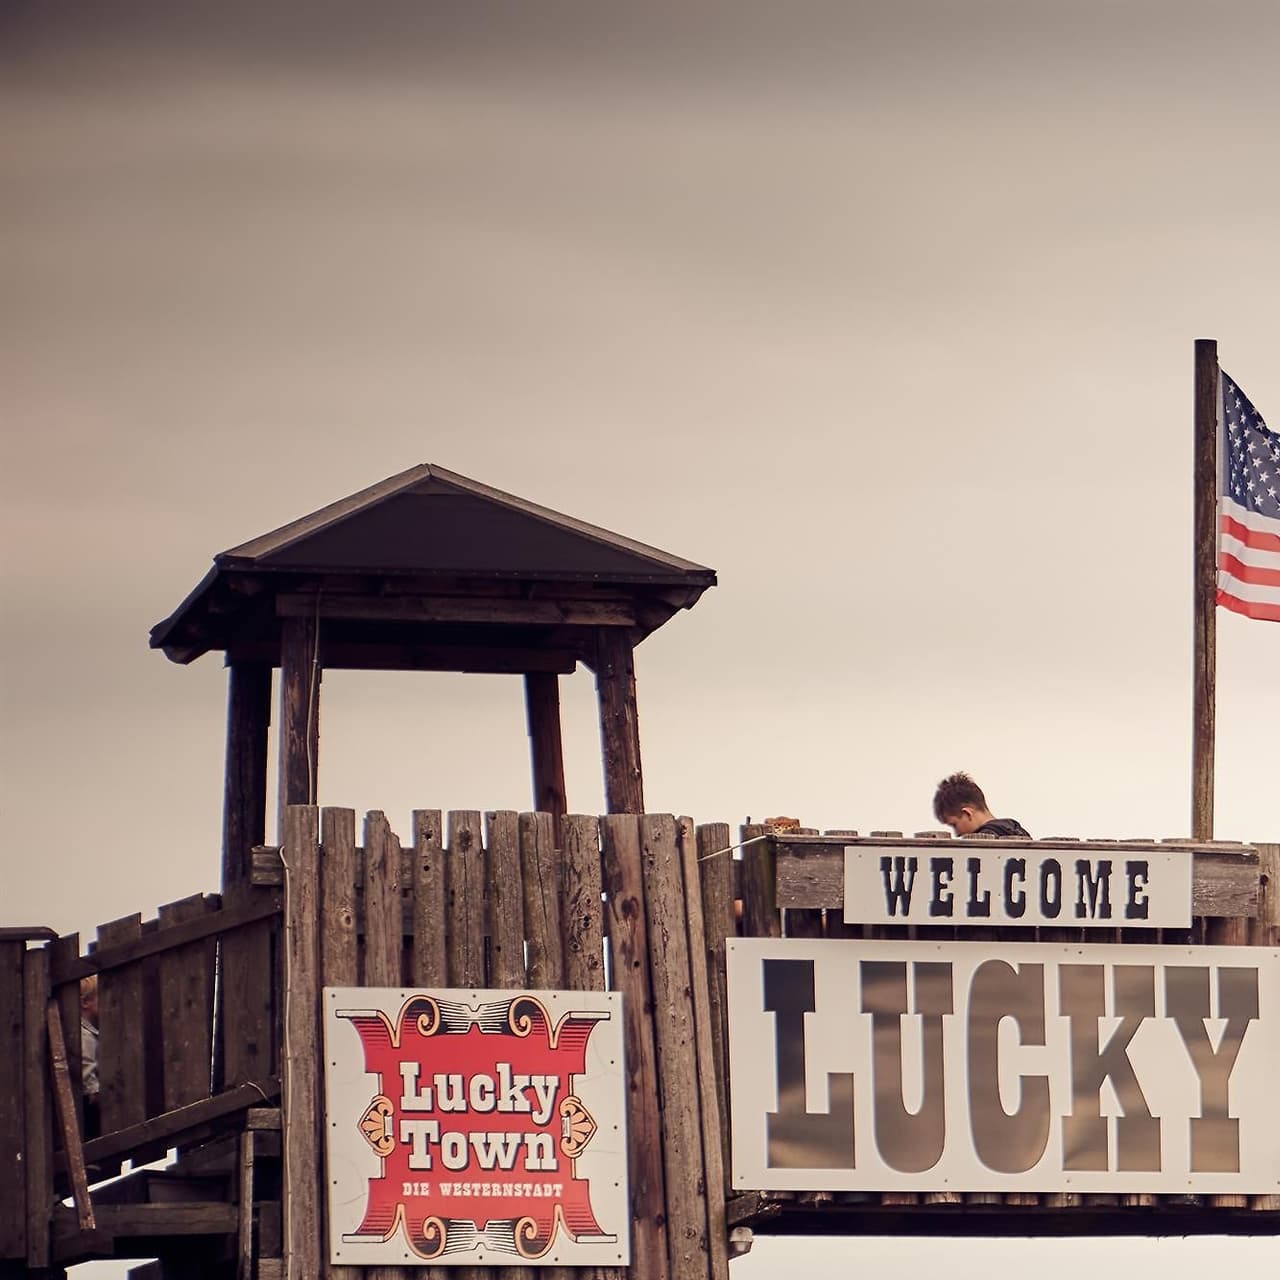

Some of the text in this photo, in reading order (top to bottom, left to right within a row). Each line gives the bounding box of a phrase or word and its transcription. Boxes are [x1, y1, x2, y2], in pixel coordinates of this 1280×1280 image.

[880, 856, 1149, 920] WELCOME
[400, 1062, 560, 1126] Lucky
[761, 958, 1260, 1174] LUCKY
[400, 1119, 559, 1171] Town
[402, 1181, 564, 1198] DIE WESTERNSTADT
